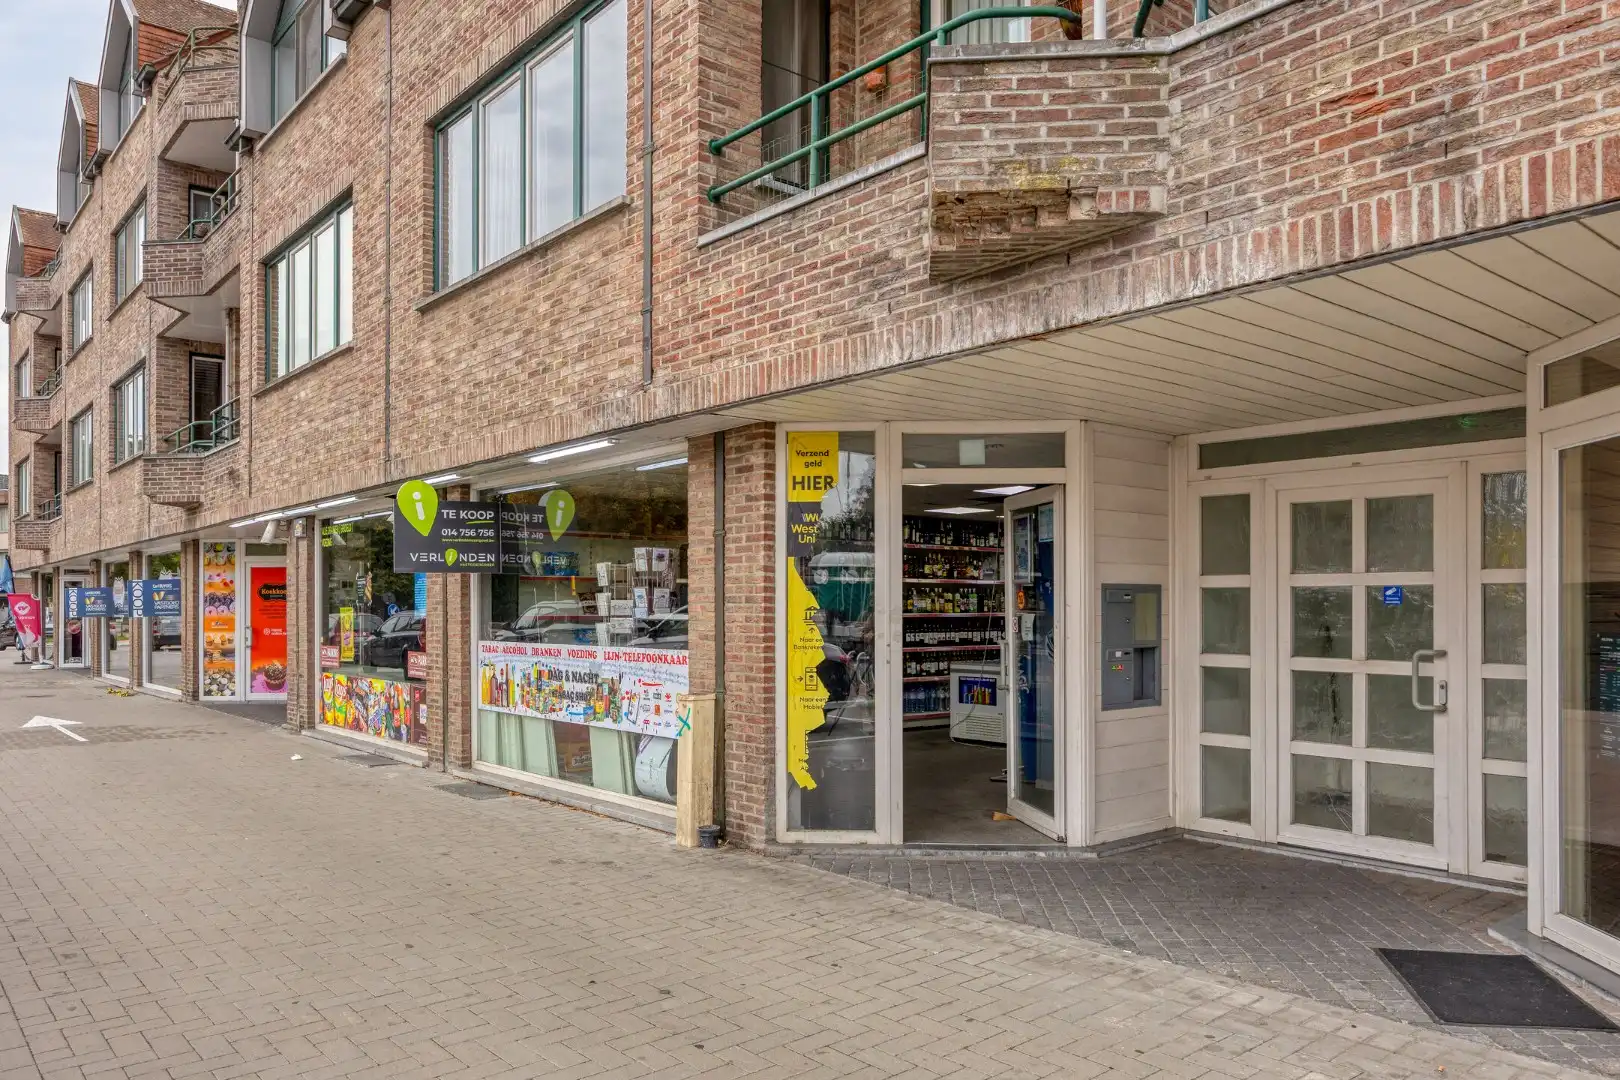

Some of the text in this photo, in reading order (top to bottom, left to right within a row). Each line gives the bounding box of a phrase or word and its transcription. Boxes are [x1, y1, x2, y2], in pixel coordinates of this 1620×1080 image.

[804, 460, 822, 468] geld
[792, 475, 834, 490] HIER
[441, 509, 494, 520] TE KOOP
[441, 528, 495, 537] 014 756 756
[69, 587, 77, 617] KOOP
[132, 580, 144, 618] KOOP
[531, 647, 562, 658] DRANKEN
[567, 648, 598, 660] VOEDING
[547, 670, 600, 684] DAG & NACHT
